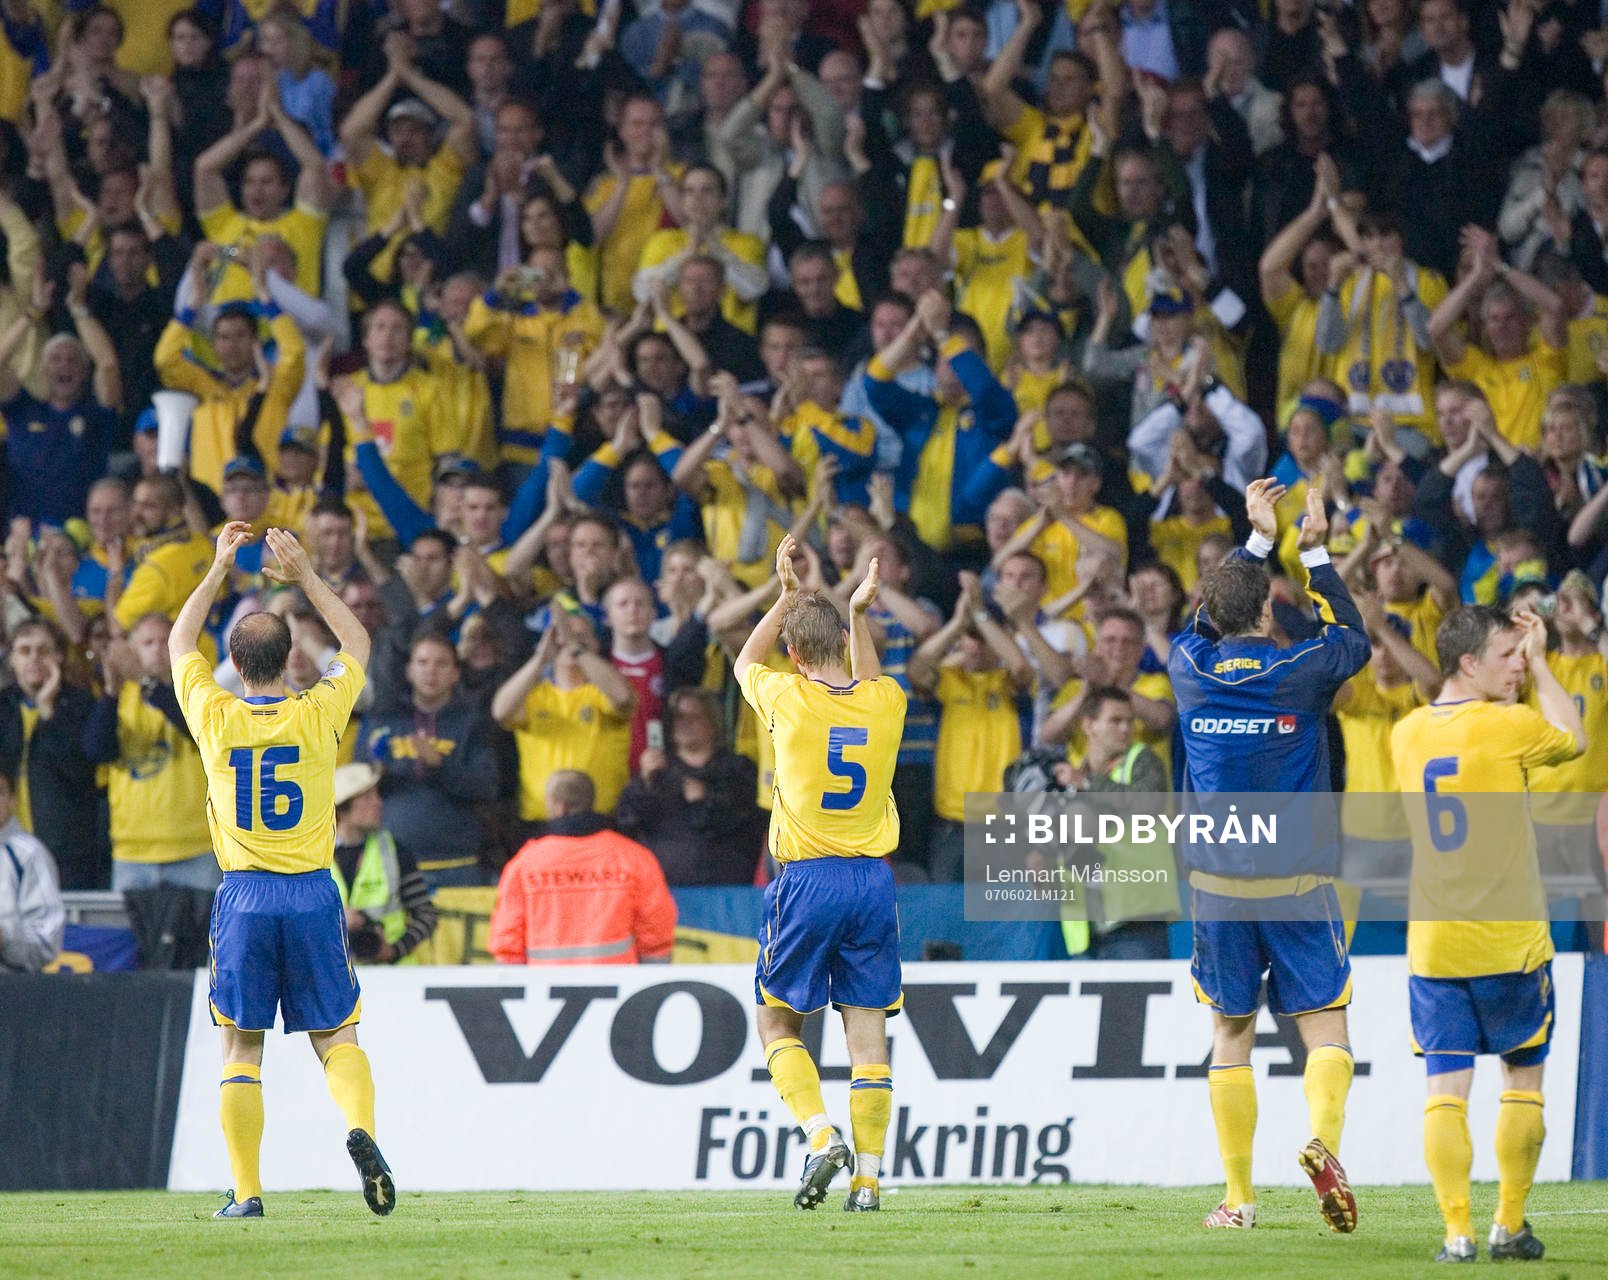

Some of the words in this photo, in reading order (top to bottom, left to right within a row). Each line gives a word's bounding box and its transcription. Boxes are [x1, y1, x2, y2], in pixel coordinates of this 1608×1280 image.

[821, 726, 868, 810] 5
[1190, 718, 1276, 735] ODDSET
[229, 746, 303, 832] 16
[1424, 757, 1468, 852] 6
[695, 1106, 1074, 1183] Förkring
